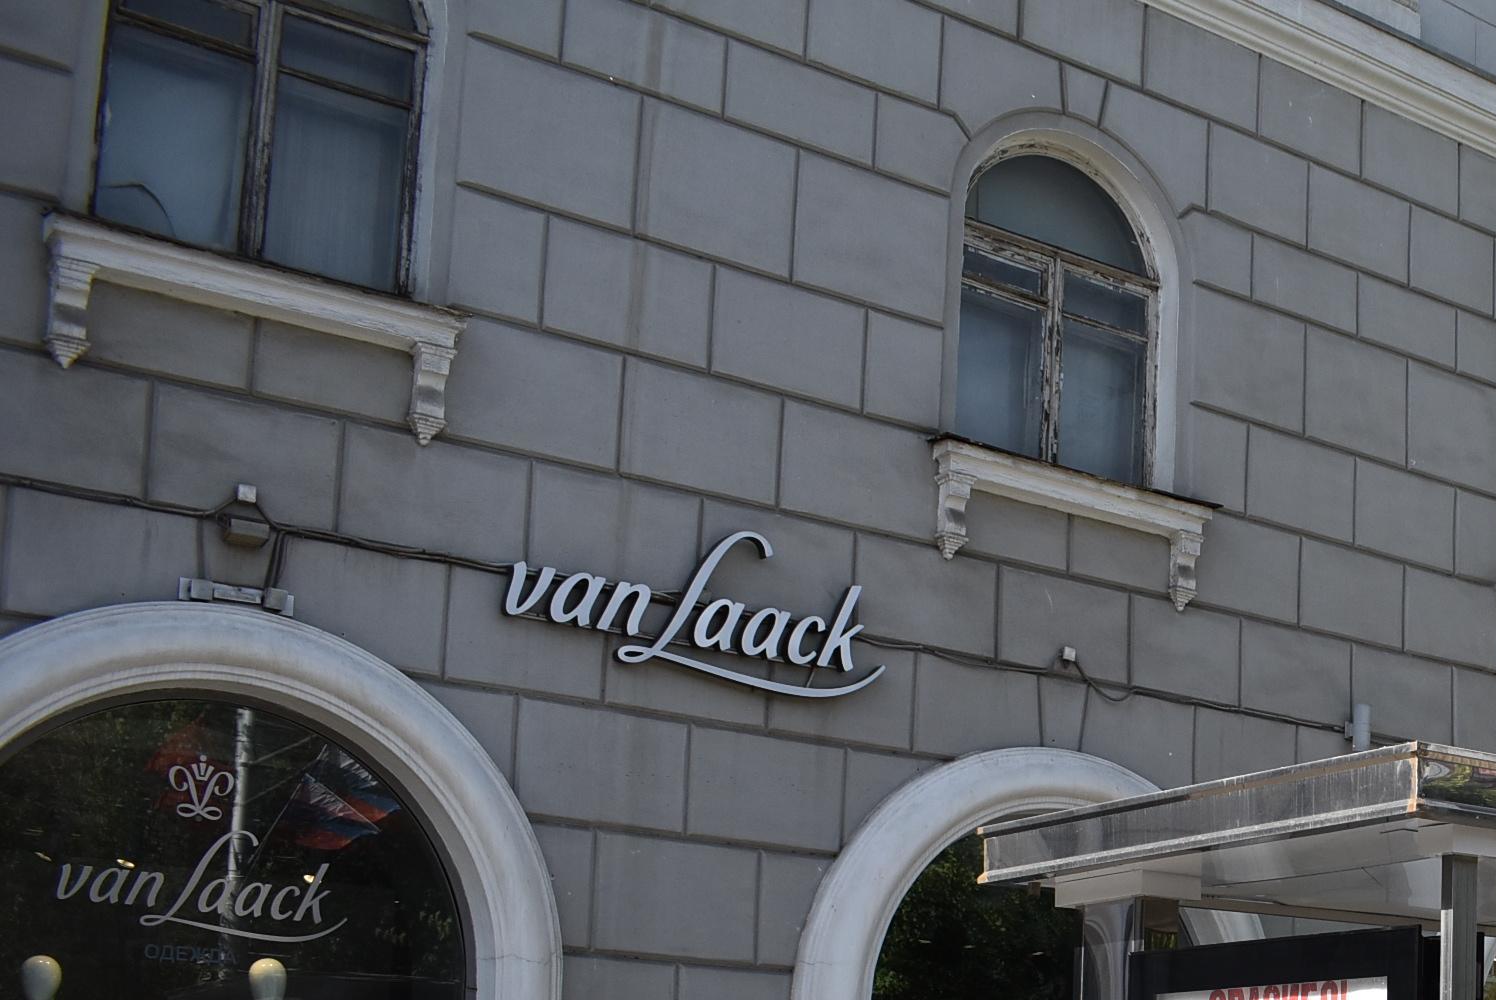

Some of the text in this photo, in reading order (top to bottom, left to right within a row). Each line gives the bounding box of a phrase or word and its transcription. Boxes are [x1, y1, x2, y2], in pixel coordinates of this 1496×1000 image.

[503, 530, 886, 698] van Laack
[56, 830, 348, 943] van Laack
[144, 943, 237, 966] ОДЕЖДА
